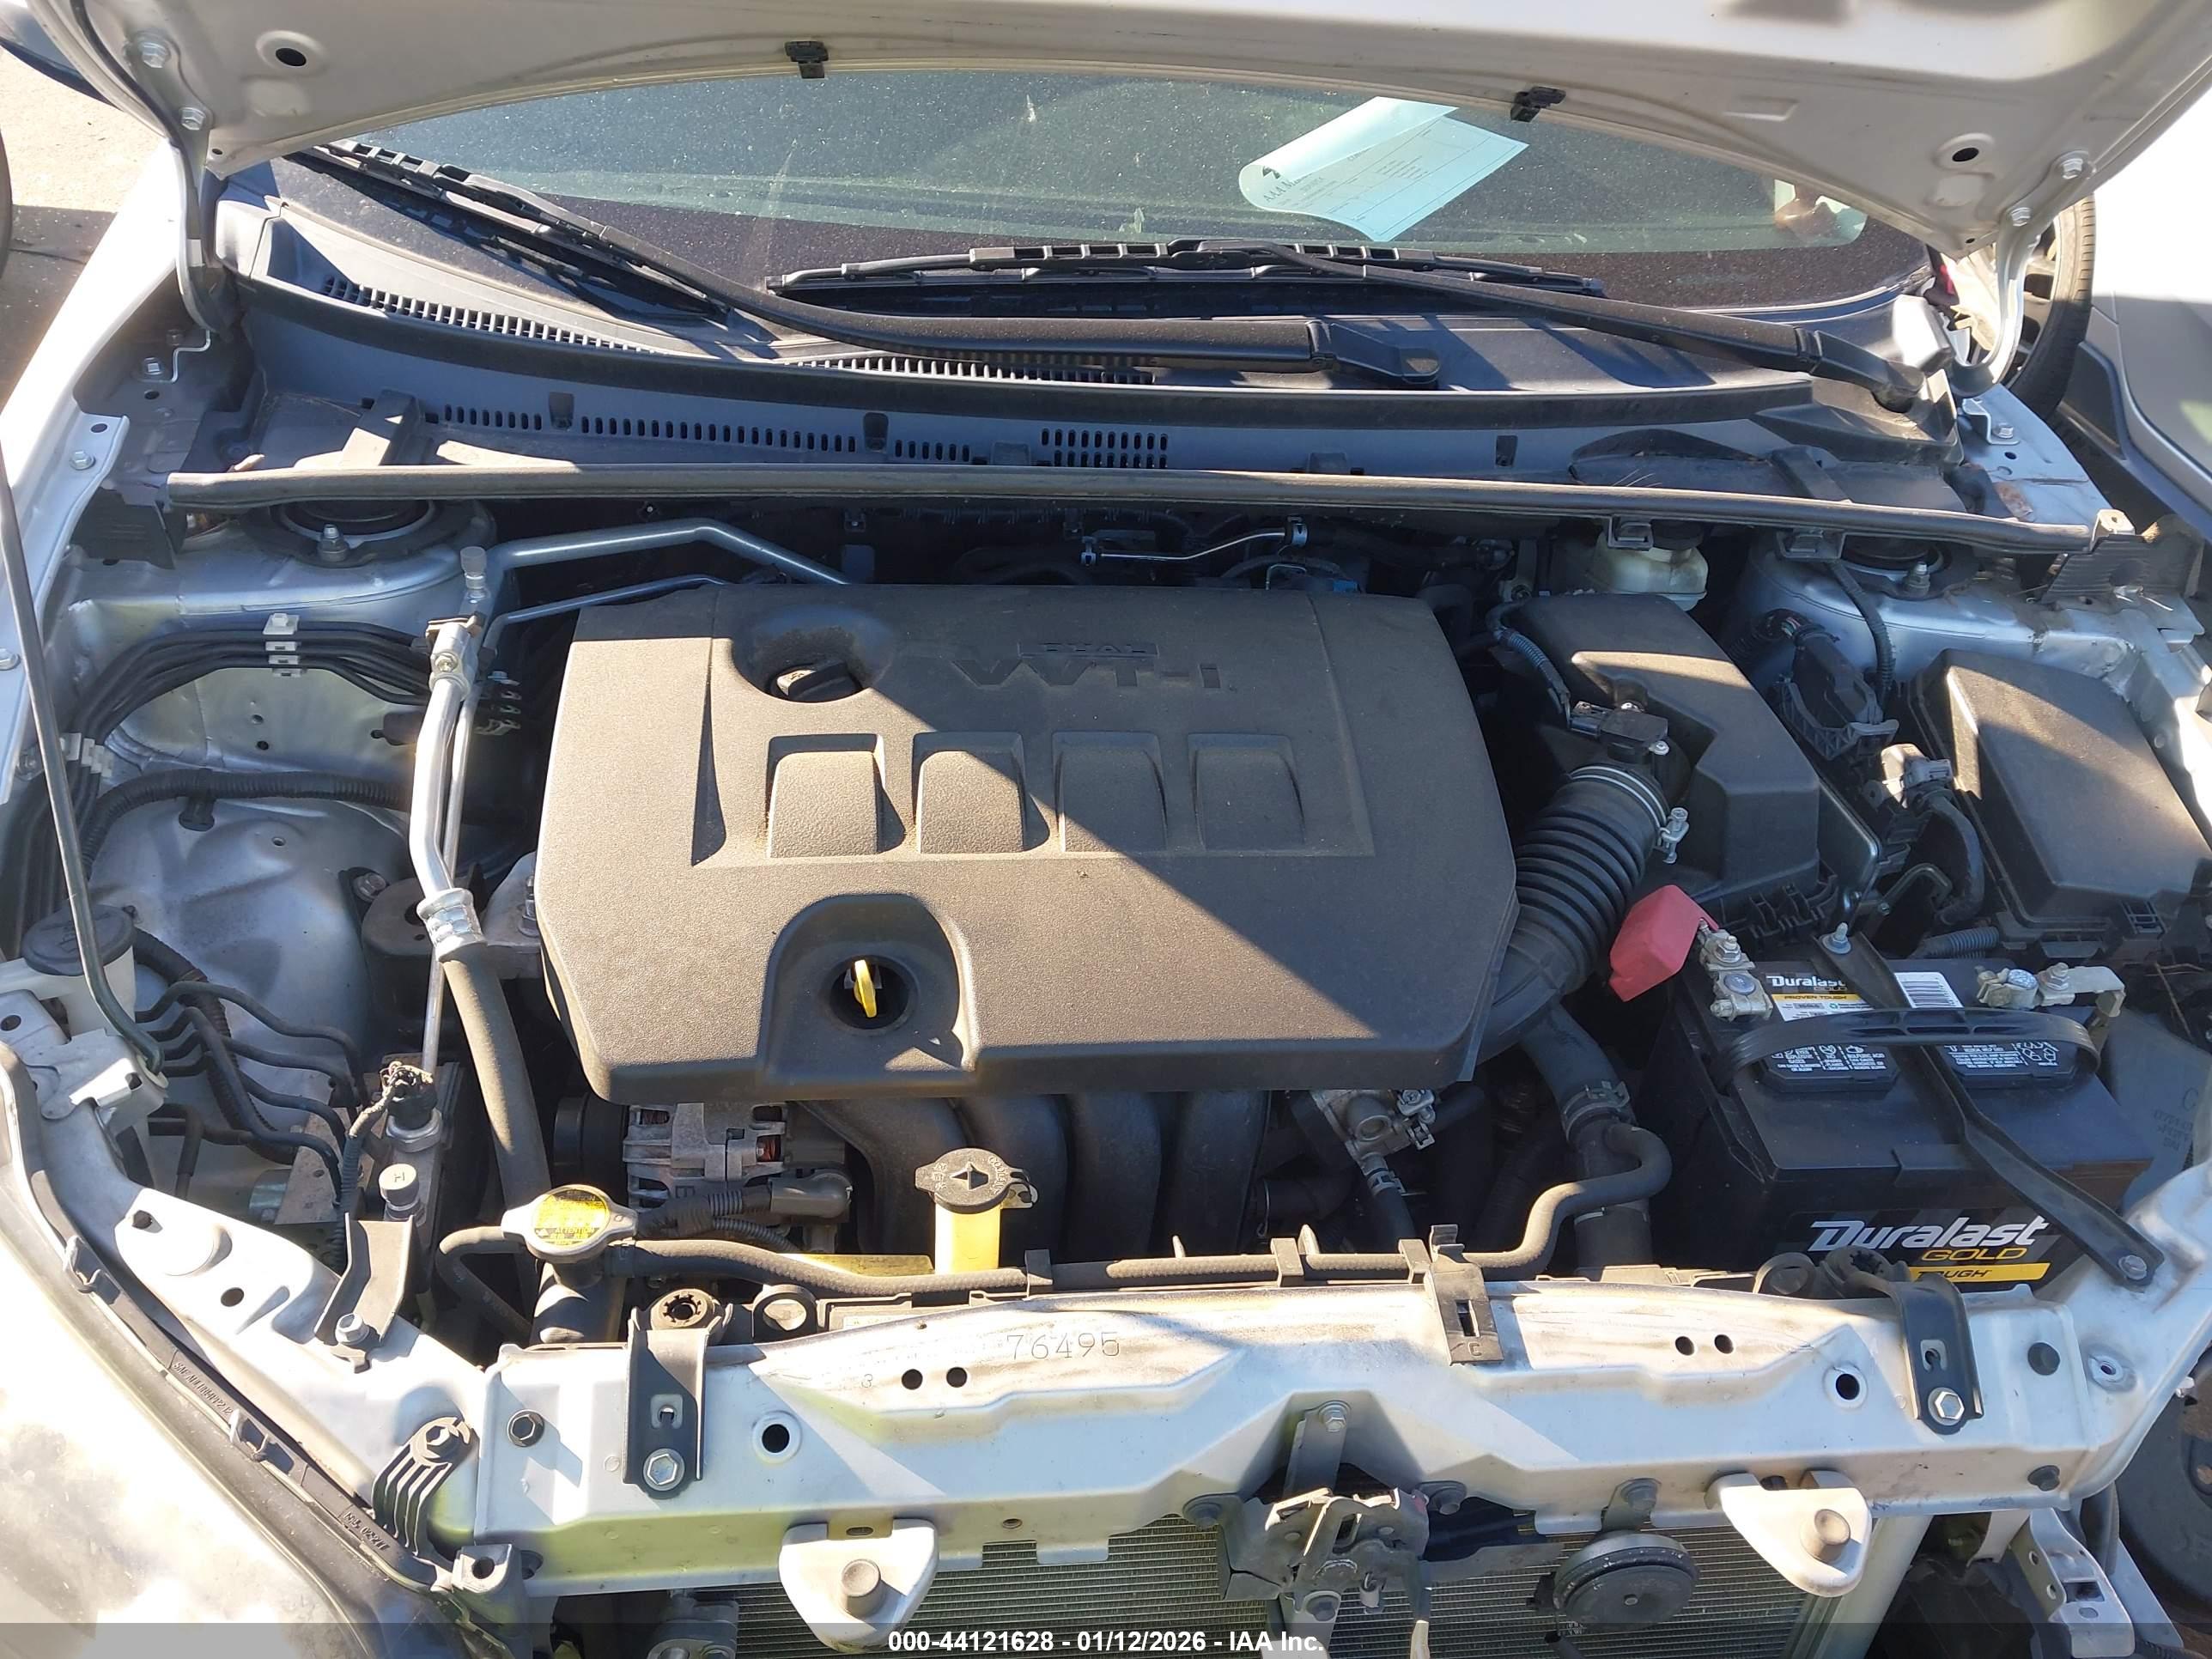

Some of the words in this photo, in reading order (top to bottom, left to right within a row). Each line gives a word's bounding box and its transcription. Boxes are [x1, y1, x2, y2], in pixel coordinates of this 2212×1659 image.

[1808, 1215, 2050, 1252] Duralast
[1922, 1247, 2027, 1261] GOLD
[1917, 1269, 1989, 1281] TUGH
[1006, 1331, 1120, 1359] 76495
[860, 1373, 873, 1388] 3
